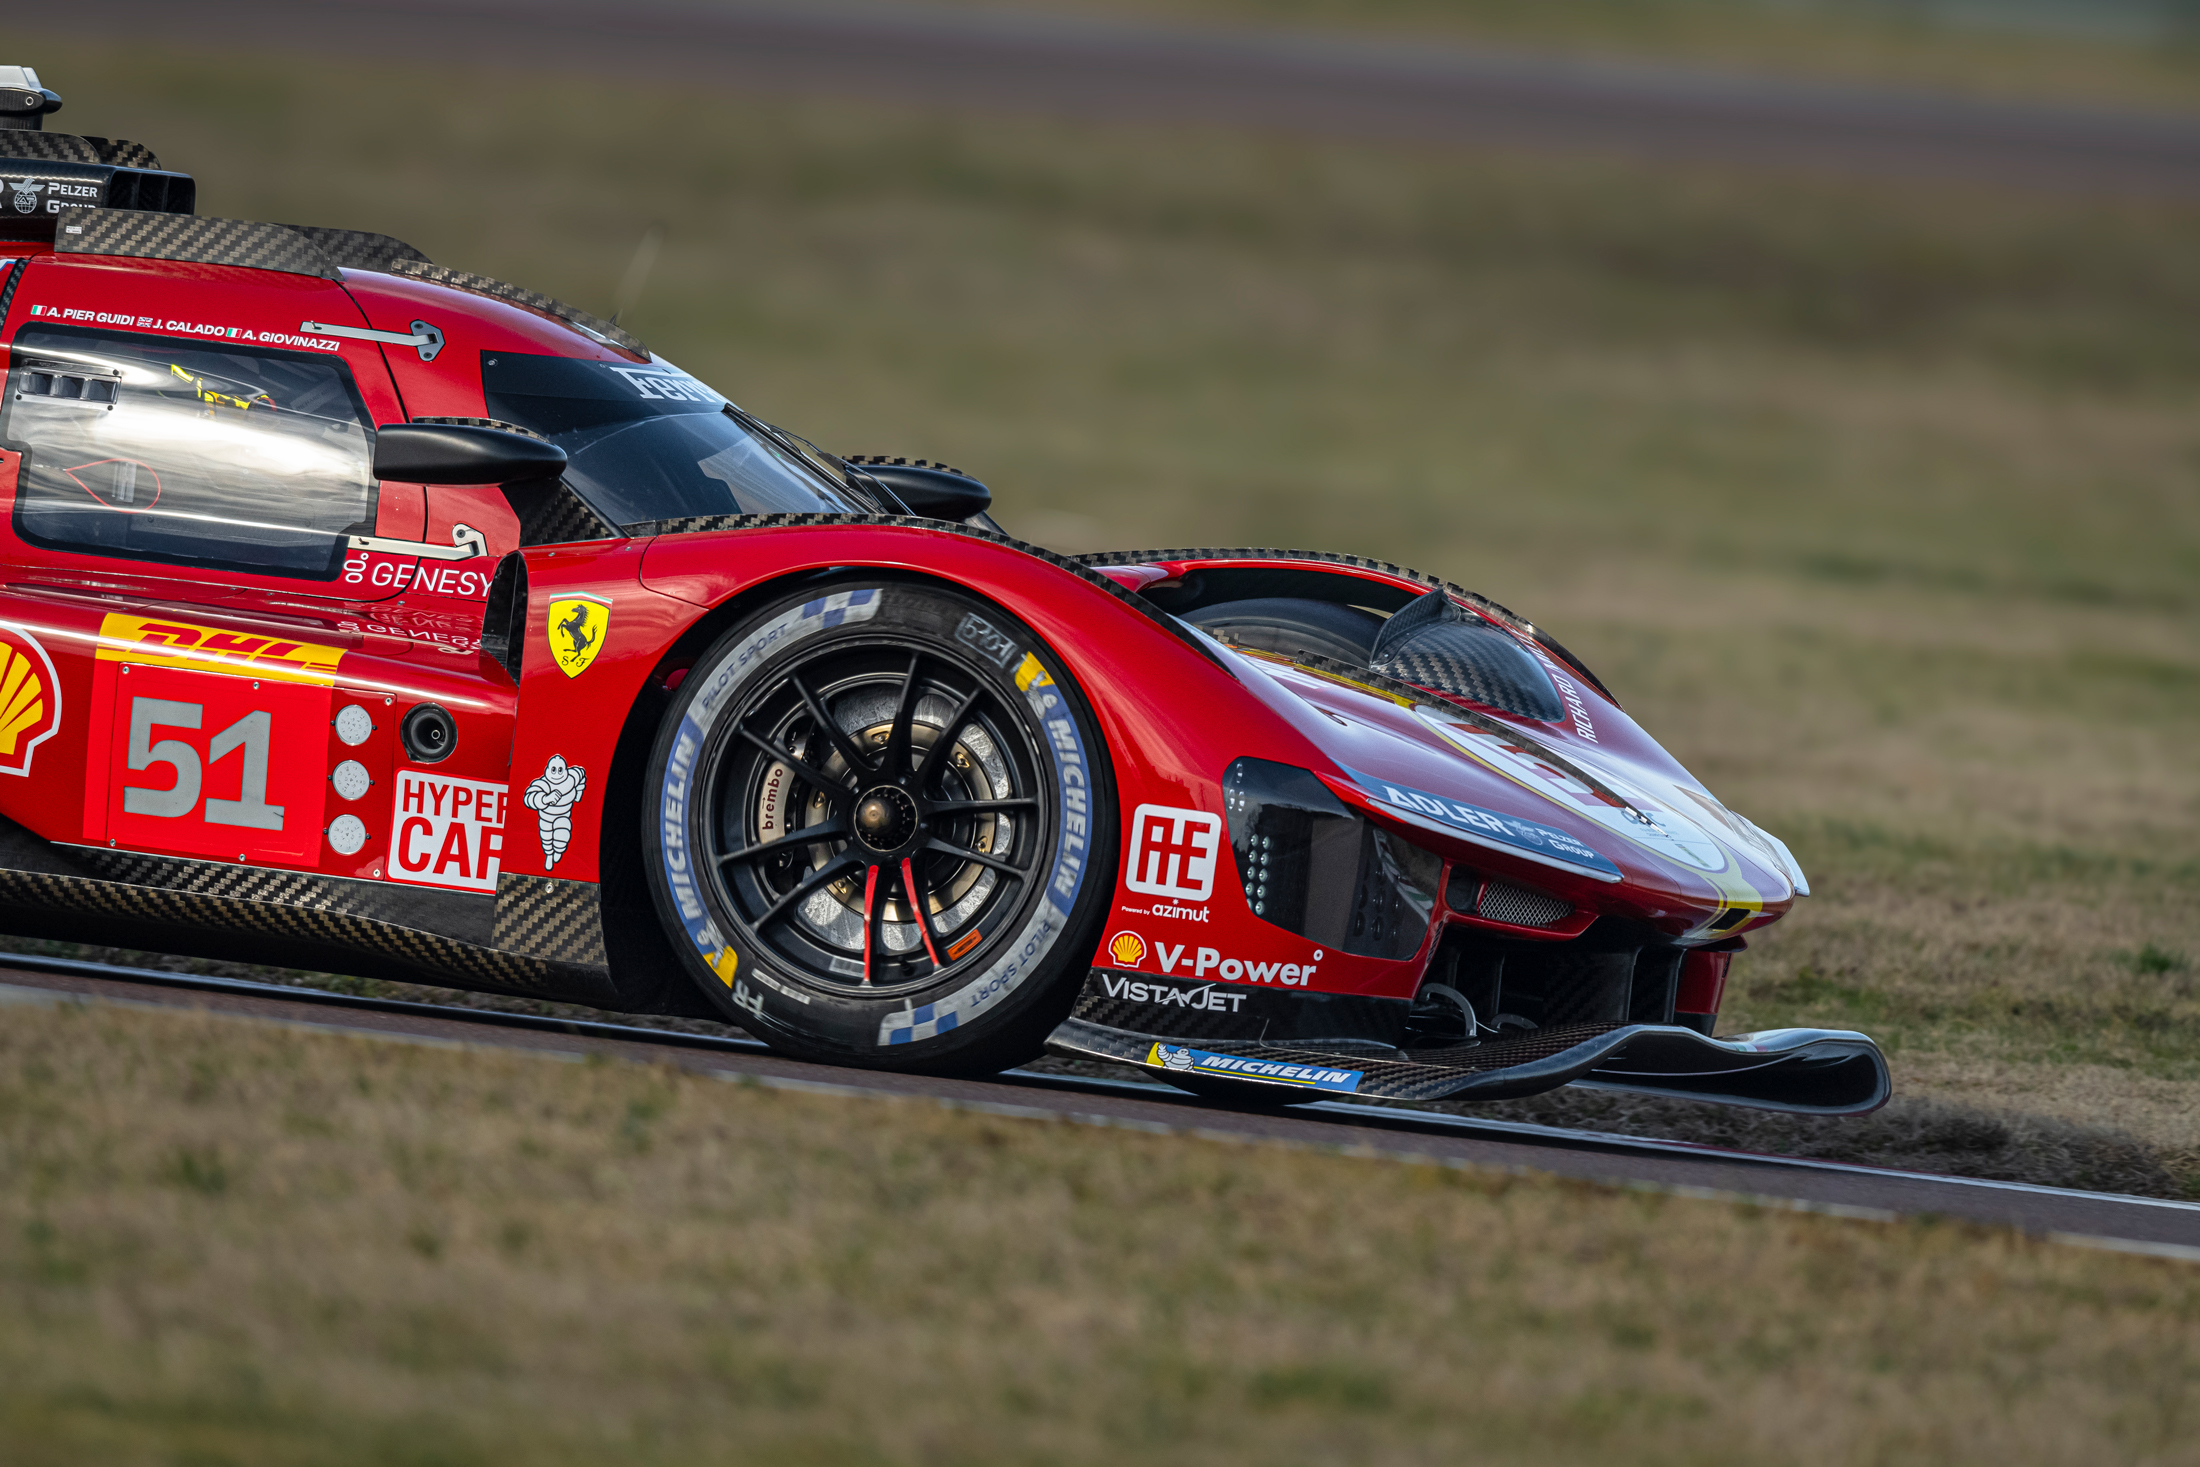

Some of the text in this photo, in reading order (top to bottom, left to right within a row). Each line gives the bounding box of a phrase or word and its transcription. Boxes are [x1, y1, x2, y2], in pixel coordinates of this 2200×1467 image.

[47, 182, 98, 198] PELZER
[46, 307, 135, 326] A. PIER GUIDI
[152, 319, 225, 336] J. CALADO
[242, 330, 340, 352] A. GIOVINAZZI
[129, 622, 310, 672] DHL
[701, 623, 788, 711] PILOT SPORT
[1551, 672, 1599, 744] RICHARD
[123, 696, 285, 831] 51
[762, 768, 783, 830] brembo
[1047, 719, 1087, 899] MICHELIN
[1382, 785, 1516, 837] ADLER
[665, 731, 703, 920] MICHELIN
[1548, 838, 1595, 859] GROUP
[1121, 899, 1210, 923] Powered by azimut
[970, 919, 1051, 1008] PILOT SPORT
[1154, 941, 1317, 986] V-Power
[1201, 1055, 1352, 1084] MICHELIN
